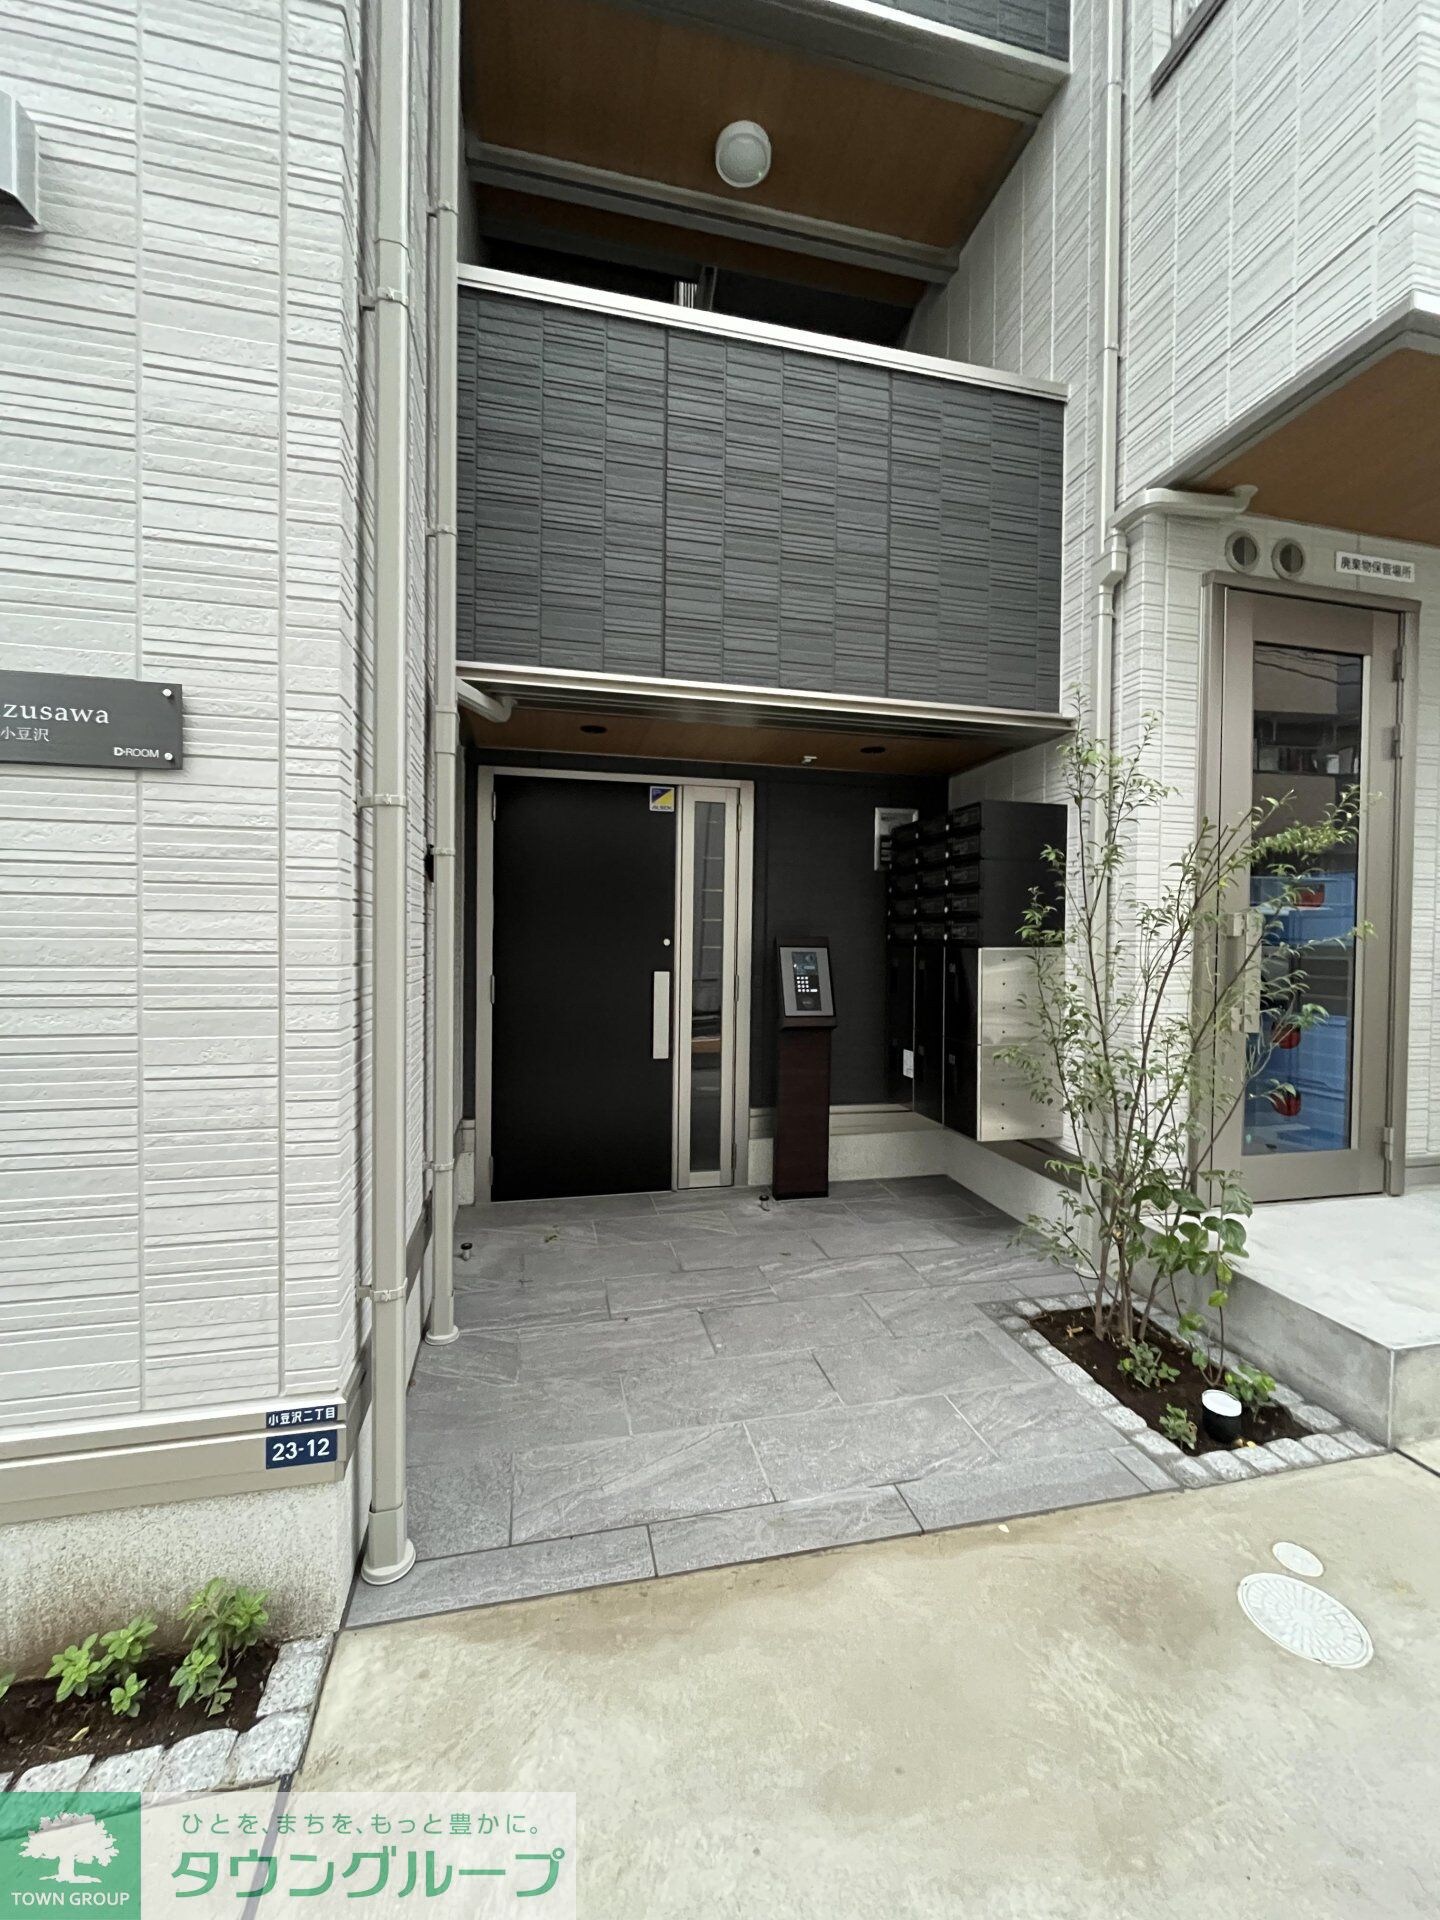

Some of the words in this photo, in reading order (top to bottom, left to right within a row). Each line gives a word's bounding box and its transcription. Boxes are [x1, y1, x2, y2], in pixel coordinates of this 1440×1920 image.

[1341, 556, 1411, 579] 廃棄物保管場所
[3, 703, 109, 724] zusawa
[0, 726, 50, 742] 小豆沢
[268, 1407, 335, 1426] 小豆沢二丁目
[272, 1438, 330, 1461] 23-12
